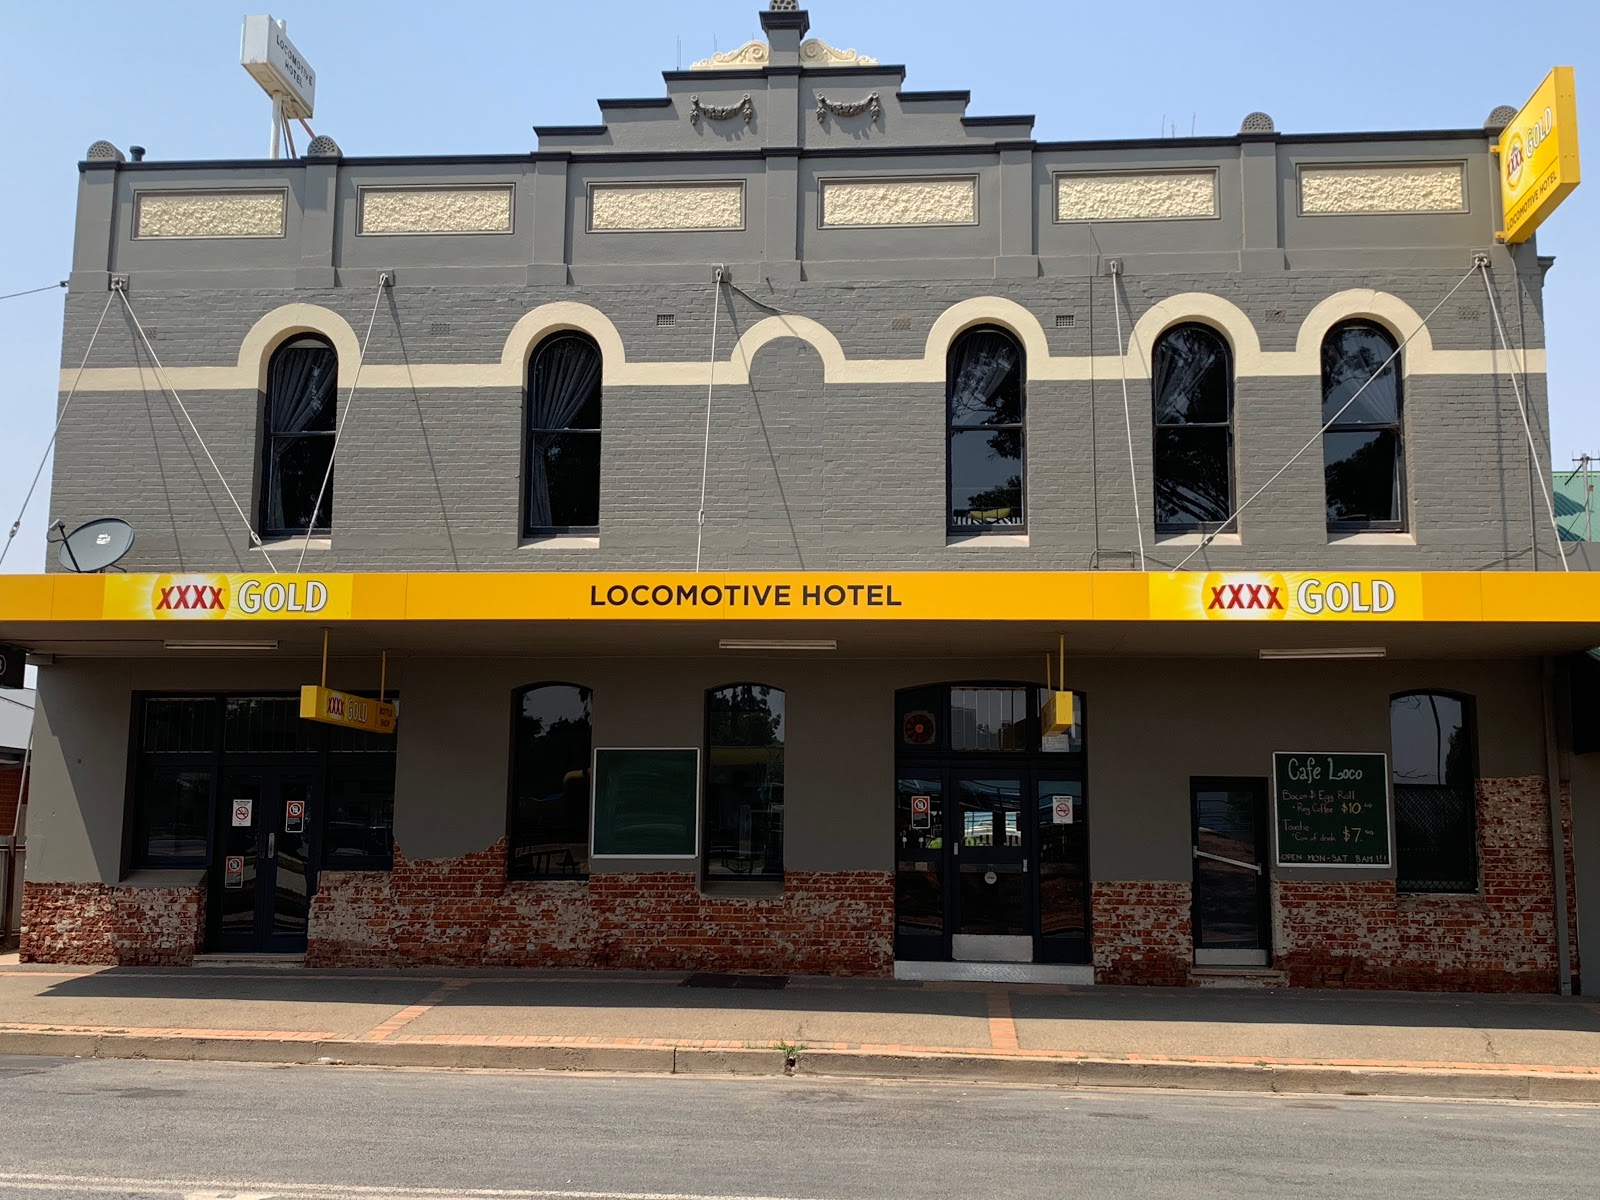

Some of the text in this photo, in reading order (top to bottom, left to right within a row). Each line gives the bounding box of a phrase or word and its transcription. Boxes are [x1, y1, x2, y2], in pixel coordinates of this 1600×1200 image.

[276, 34, 313, 86] LOCOMOTIVE
[285, 59, 303, 88] HOTEL
[1506, 106, 1553, 182] XXXX GOLD
[1506, 170, 1558, 231] LOCOMOTIVE HOTEL
[155, 580, 329, 614] XXXX GOLD
[591, 584, 902, 606] LOCOMOTIVE HOTEL
[1207, 578, 1396, 614] XXXX GOLD
[327, 697, 367, 723] XXXX GOLD
[379, 707, 393, 717] BOTTLE
[380, 719, 391, 727] SHOP
[1288, 757, 1363, 784] Cafe Loco
[1282, 789, 1308, 800] Bacon
[1318, 790, 1334, 804] Egg
[1337, 790, 1355, 800] Roll
[1312, 803, 1334, 813] Coffee
[1280, 853, 1303, 861] OPEN
